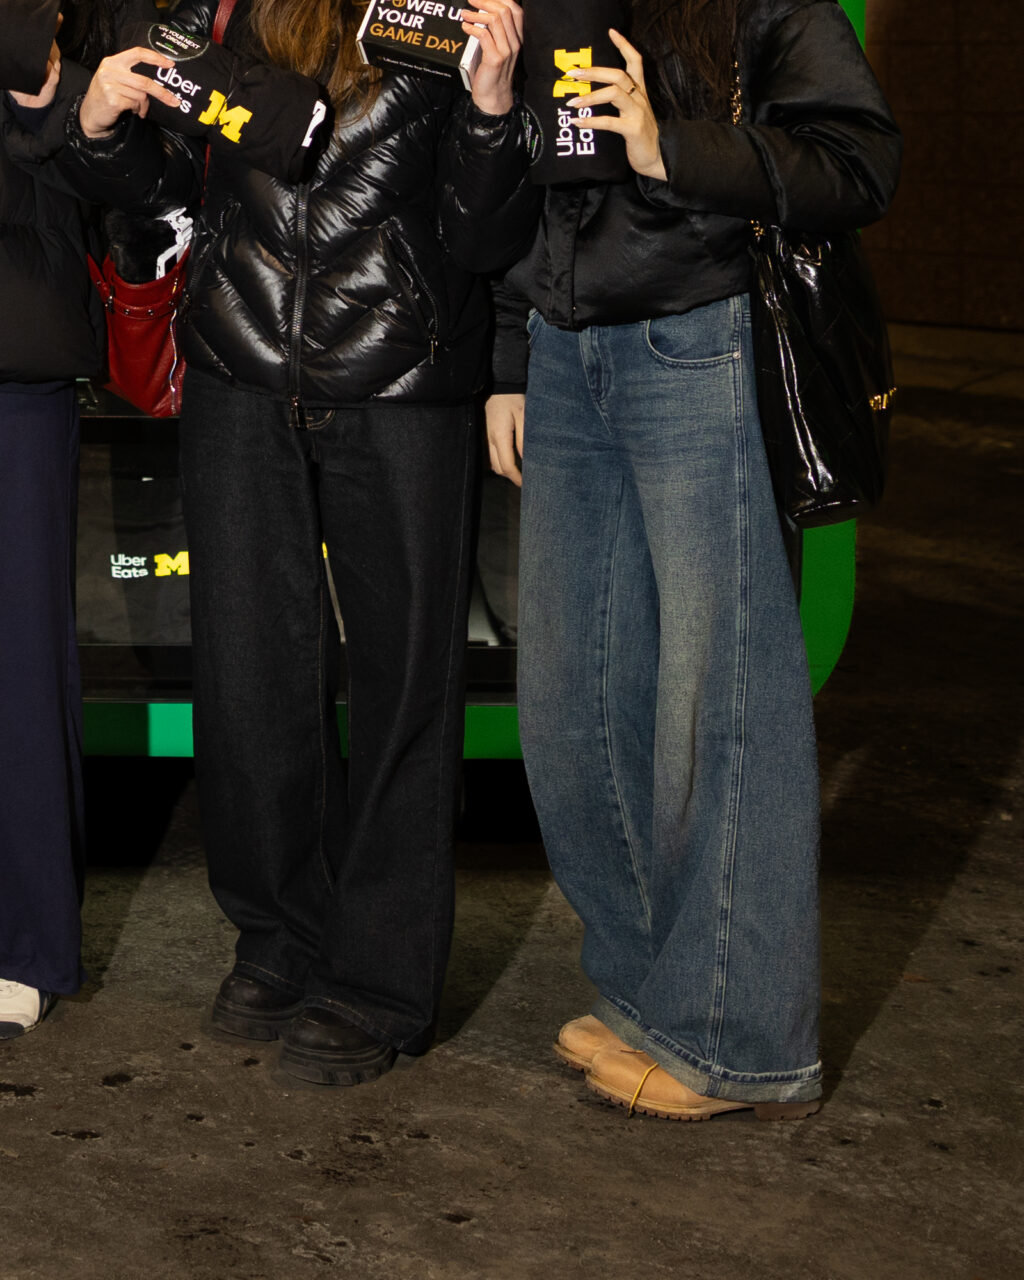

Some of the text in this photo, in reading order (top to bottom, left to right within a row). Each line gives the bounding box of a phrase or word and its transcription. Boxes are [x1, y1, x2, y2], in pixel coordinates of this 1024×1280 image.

[377, 6, 425, 30] YOUR
[447, 6, 464, 22] U
[370, 23, 463, 54] GAME DAY
[197, 89, 253, 144] M
[555, 107, 574, 157] Uber
[576, 106, 596, 156] Eas
[110, 553, 147, 567] Uber
[111, 565, 149, 579] Eats
[154, 550, 190, 577] M
